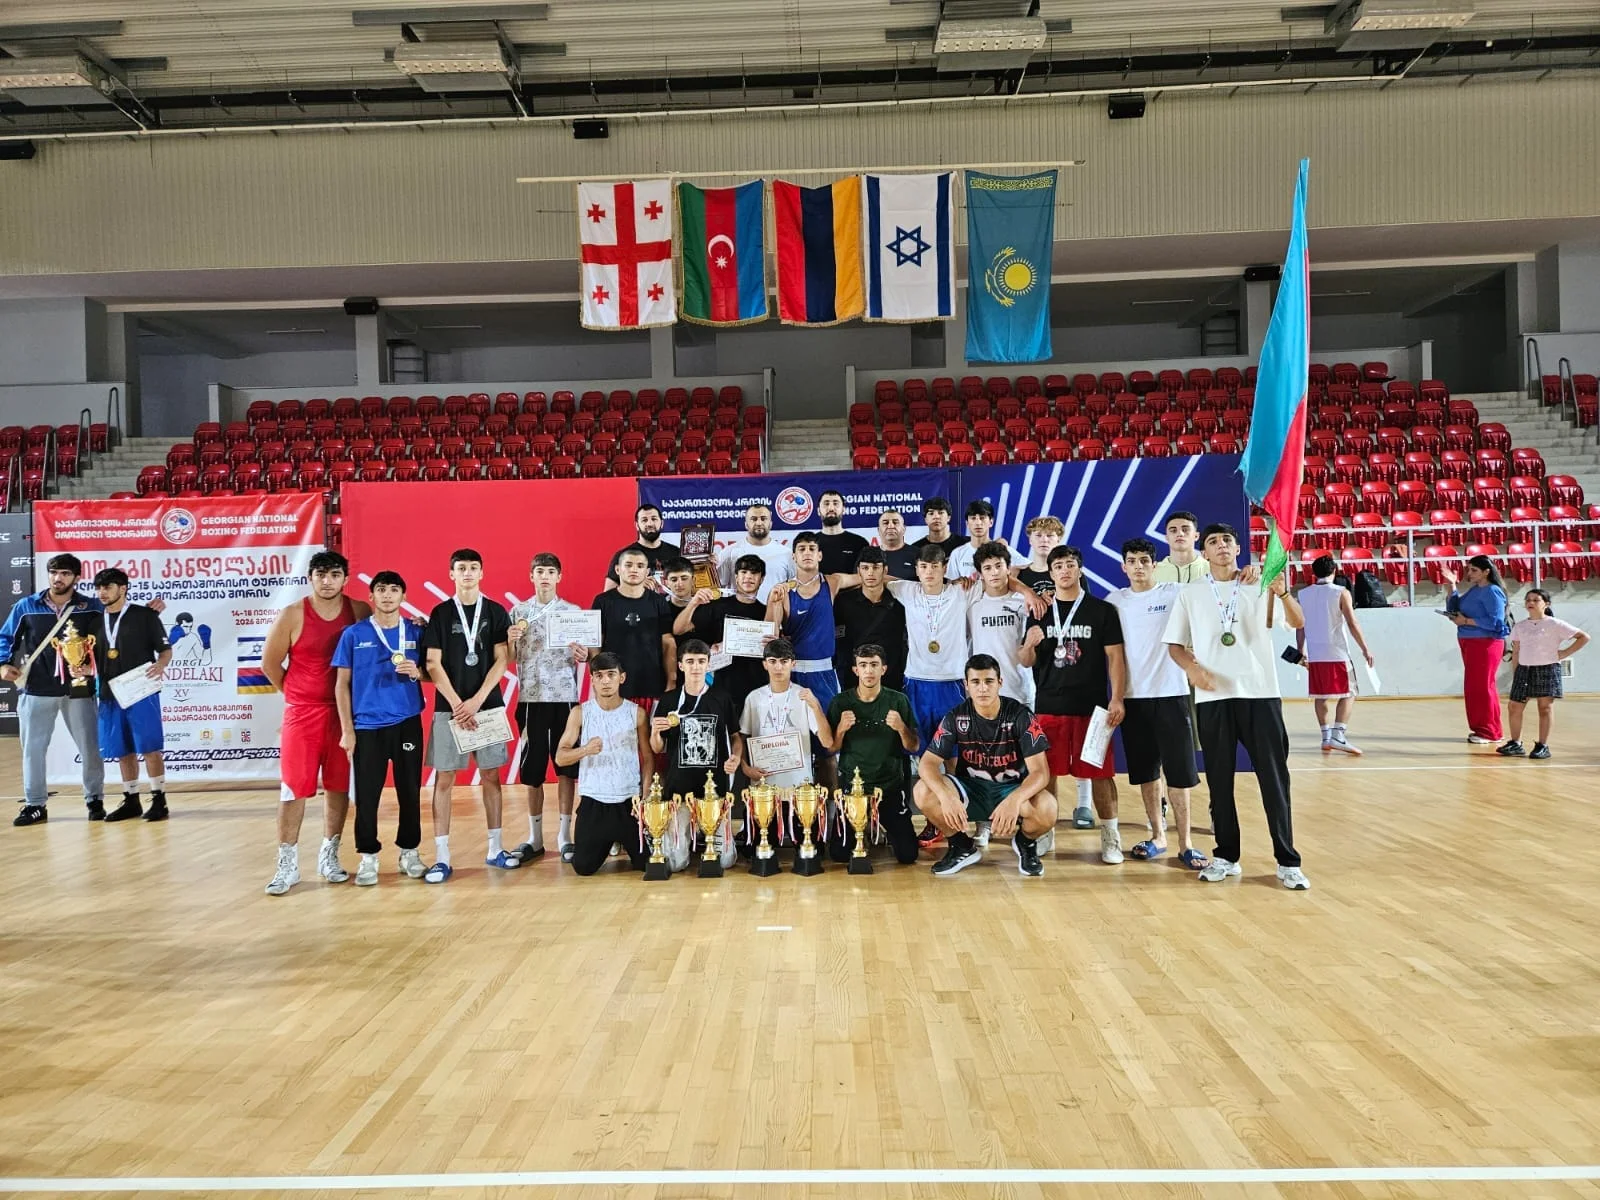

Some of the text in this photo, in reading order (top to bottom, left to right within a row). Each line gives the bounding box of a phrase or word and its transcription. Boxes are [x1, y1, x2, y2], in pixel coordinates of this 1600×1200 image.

[661, 499, 733, 508] საქართველოს
[843, 492, 923, 504] GIAN NATIONAL
[201, 514, 299, 525] GEORGIAN NATIONAL
[661, 510, 714, 520] ეროვნული
[54, 518, 158, 528] საქართველოს კრივის
[54, 529, 158, 540] ეროვნული ფედერაცია
[201, 525, 297, 536] BOXING FEDERATION
[161, 554, 293, 579] კანდელაკის
[151, 577, 249, 590] საერთაშორისო
[251, 575, 308, 587] ტურნირი
[227, 588, 271, 599] შორის
[981, 614, 1015, 627] PUMA
[1046, 624, 1093, 639] BING
[170, 659, 202, 667] IORGI
[161, 666, 223, 683] NDELAKI
[173, 688, 190, 698] XV
[165, 762, 214, 772] w.gmstv.ge
